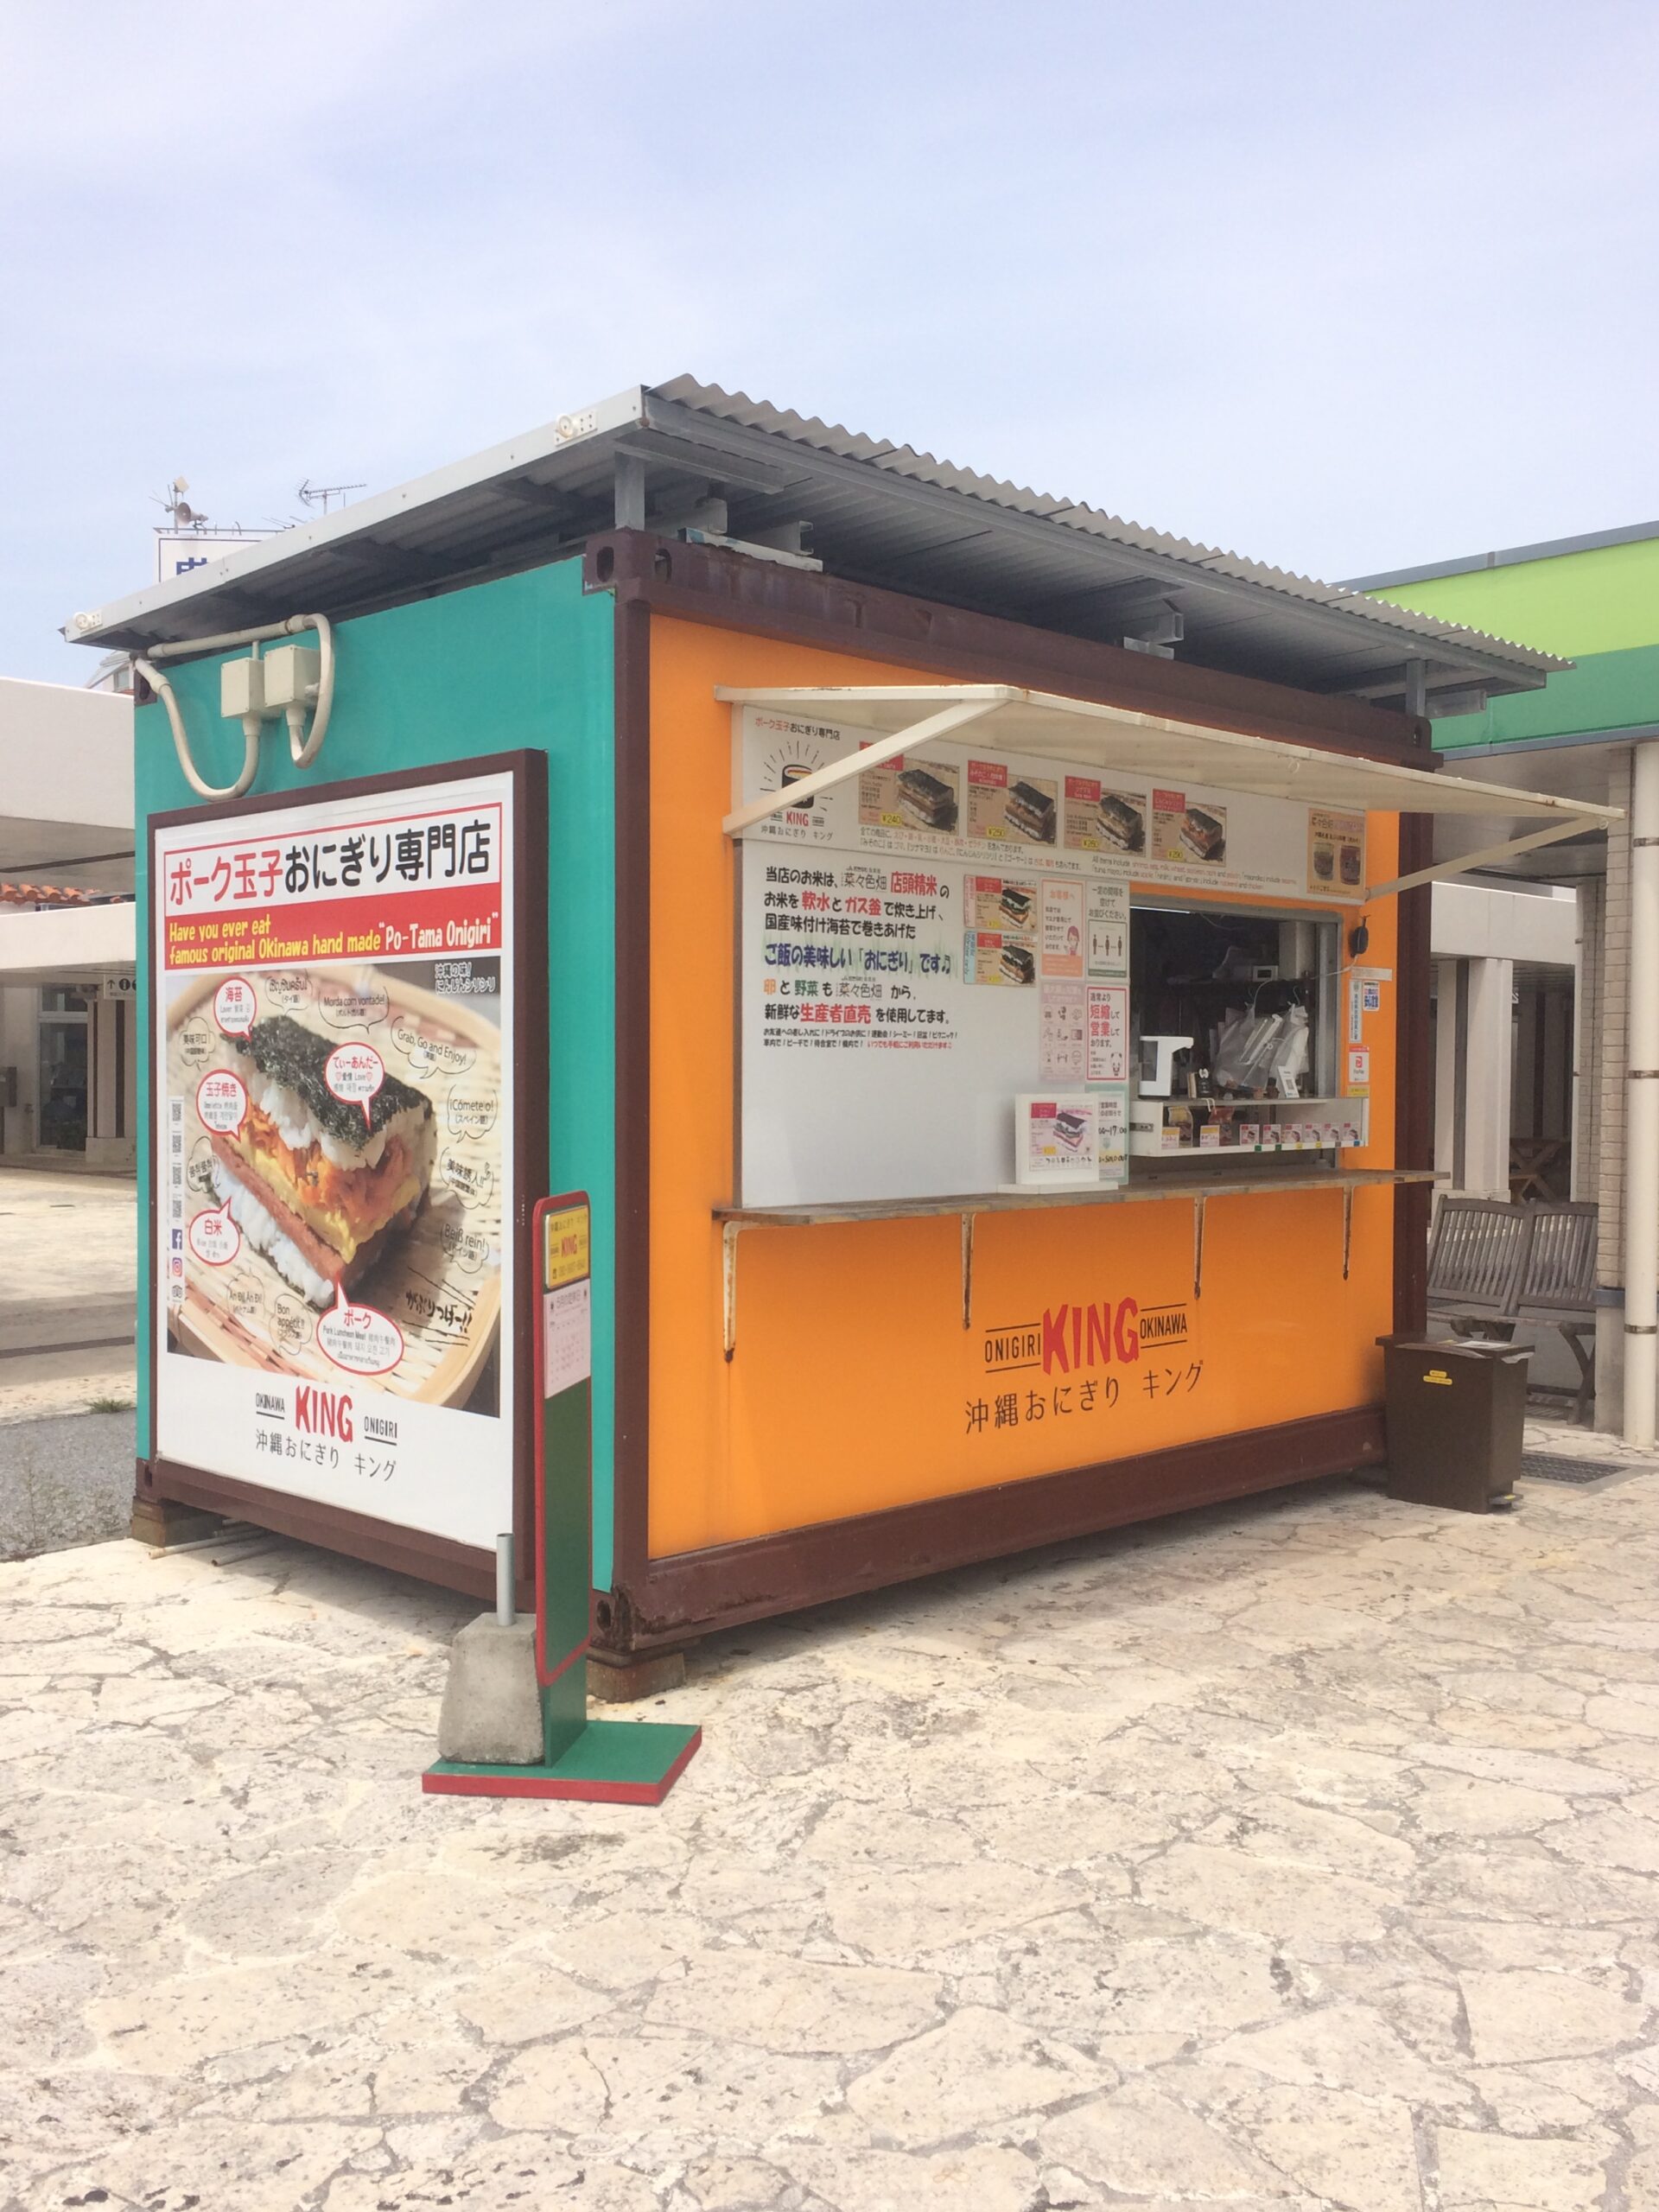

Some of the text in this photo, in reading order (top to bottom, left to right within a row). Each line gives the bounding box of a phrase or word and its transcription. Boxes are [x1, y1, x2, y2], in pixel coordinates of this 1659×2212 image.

[754, 717, 841, 741] ポーク玉子おにぎり専門店
[786, 811, 809, 827] KING
[813, 830, 833, 841] キング
[169, 819, 492, 906] ポーク玉子おにぎり専門店
[766, 866, 838, 887] 当店のお米は、
[842, 872, 888, 891] 菜々色畑
[891, 871, 938, 896] 店頭精米
[940, 885, 950, 899] の
[765, 892, 799, 908] お米を
[802, 891, 830, 912] 軟水
[832, 898, 842, 912] と
[845, 896, 881, 916] ガス釜
[169, 914, 271, 943] Have you ever eat
[765, 912, 916, 939] 国産味付け海苔で巻きあげた
[169, 944, 207, 965] famous
[211, 940, 255, 963] original
[258, 937, 308, 959] Okinawa
[313, 934, 343, 956] hand
[346, 931, 381, 951] made
[225, 987, 243, 1002] 海苔
[764, 978, 777, 995] 卵
[780, 981, 790, 995] と
[794, 980, 819, 996] 野菜
[823, 982, 833, 996] も
[836, 982, 882, 999] 菜々色畑
[1090, 993, 1111, 1002] 通常より
[324, 995, 385, 1007] Morda com vontade!
[1090, 1004, 1120, 1020] 短縮して
[1090, 1021, 1120, 1037] 営業して
[397, 1029, 467, 1065] Grab, Go and Enjoy!
[1090, 1039, 1112, 1048] おります。
[206, 1082, 238, 1096] 玉子焼き
[204, 1218, 223, 1236] 白米
[444, 1224, 486, 1249] Beiß rein!
[276, 1303, 290, 1315] Bon
[344, 1309, 372, 1329] ポーク
[322, 1325, 334, 1335] Pork
[334, 1326, 355, 1338] Luncheon
[355, 1330, 366, 1340] Meat
[985, 1297, 1187, 1375] ONIGIRI KING OKINAWA
[965, 1359, 1204, 1434] 沖縄おにぎり キング
[256, 1385, 397, 1443] OKINAWA KING ONIGIRI
[256, 1428, 397, 1482] 沖縄おにぎり キング
